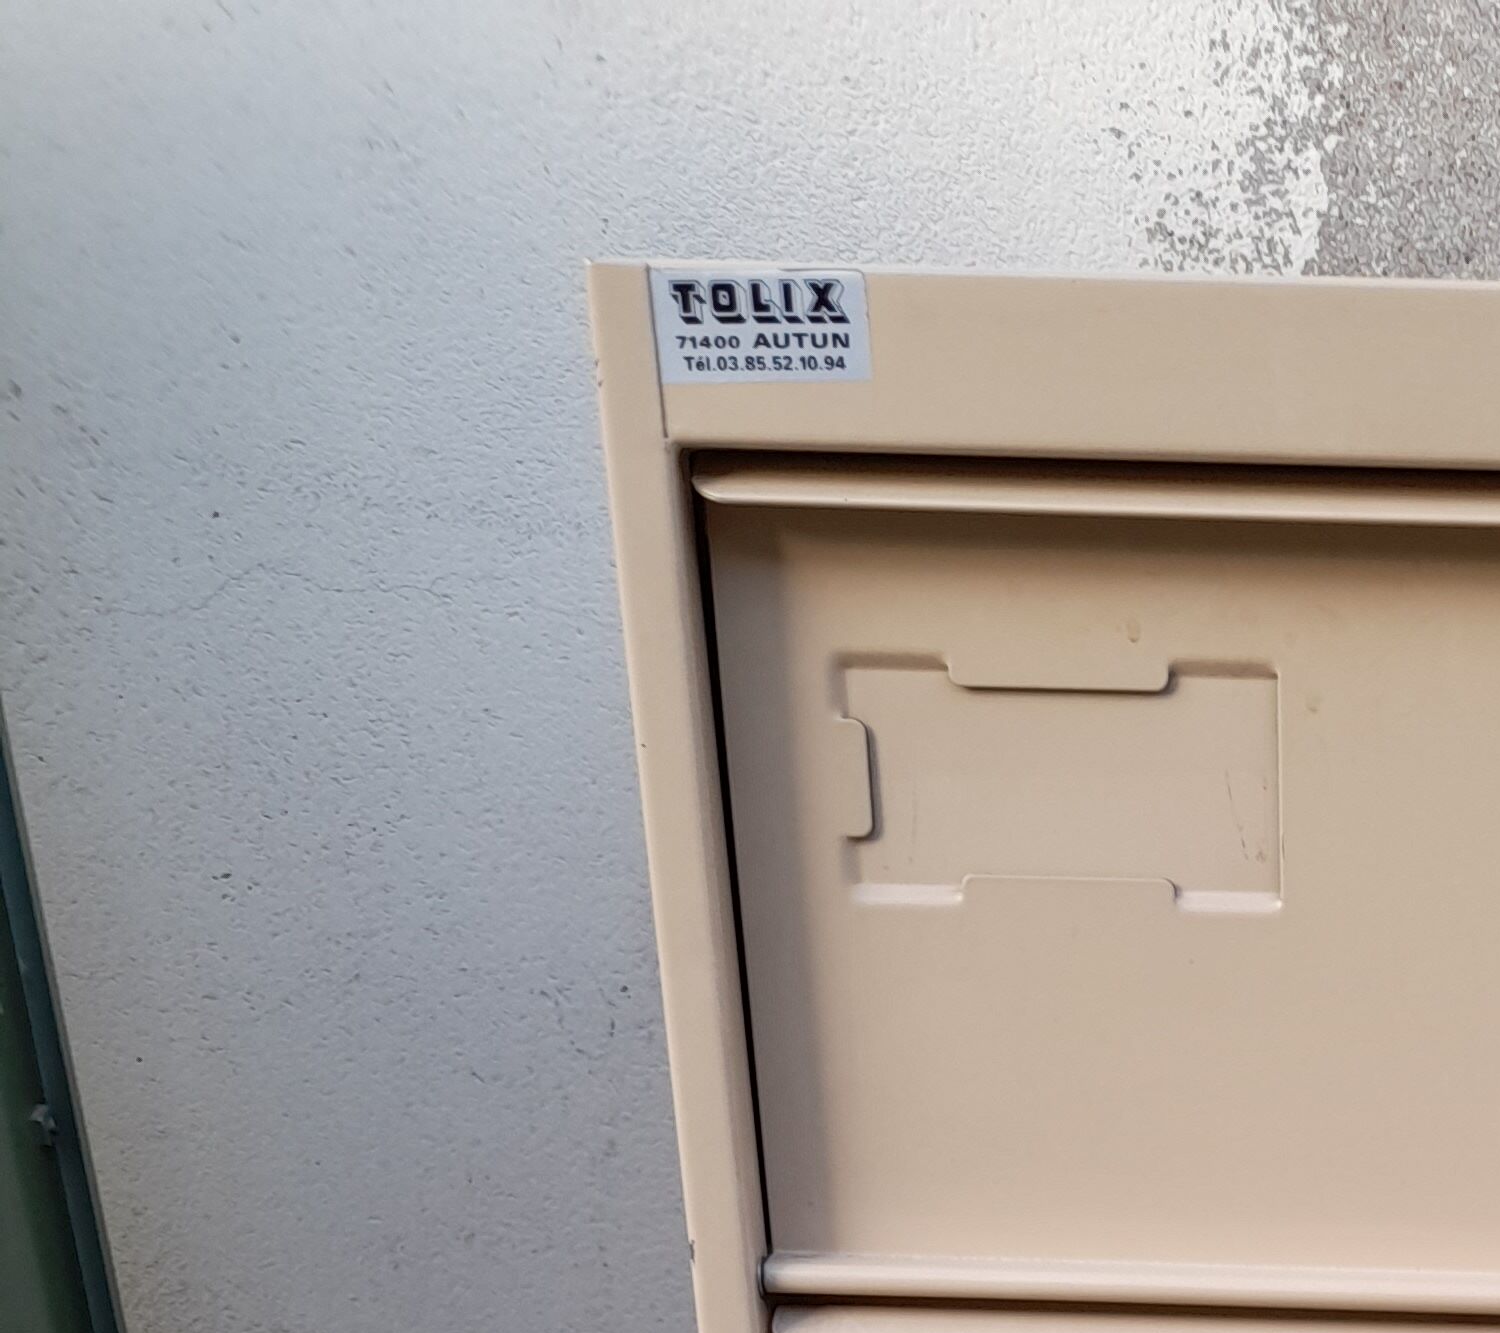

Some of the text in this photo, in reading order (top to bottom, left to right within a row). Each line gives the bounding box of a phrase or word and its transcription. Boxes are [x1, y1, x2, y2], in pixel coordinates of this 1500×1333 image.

[669, 279, 850, 324] TOLIX
[676, 333, 850, 349] 71400 AUTUN
